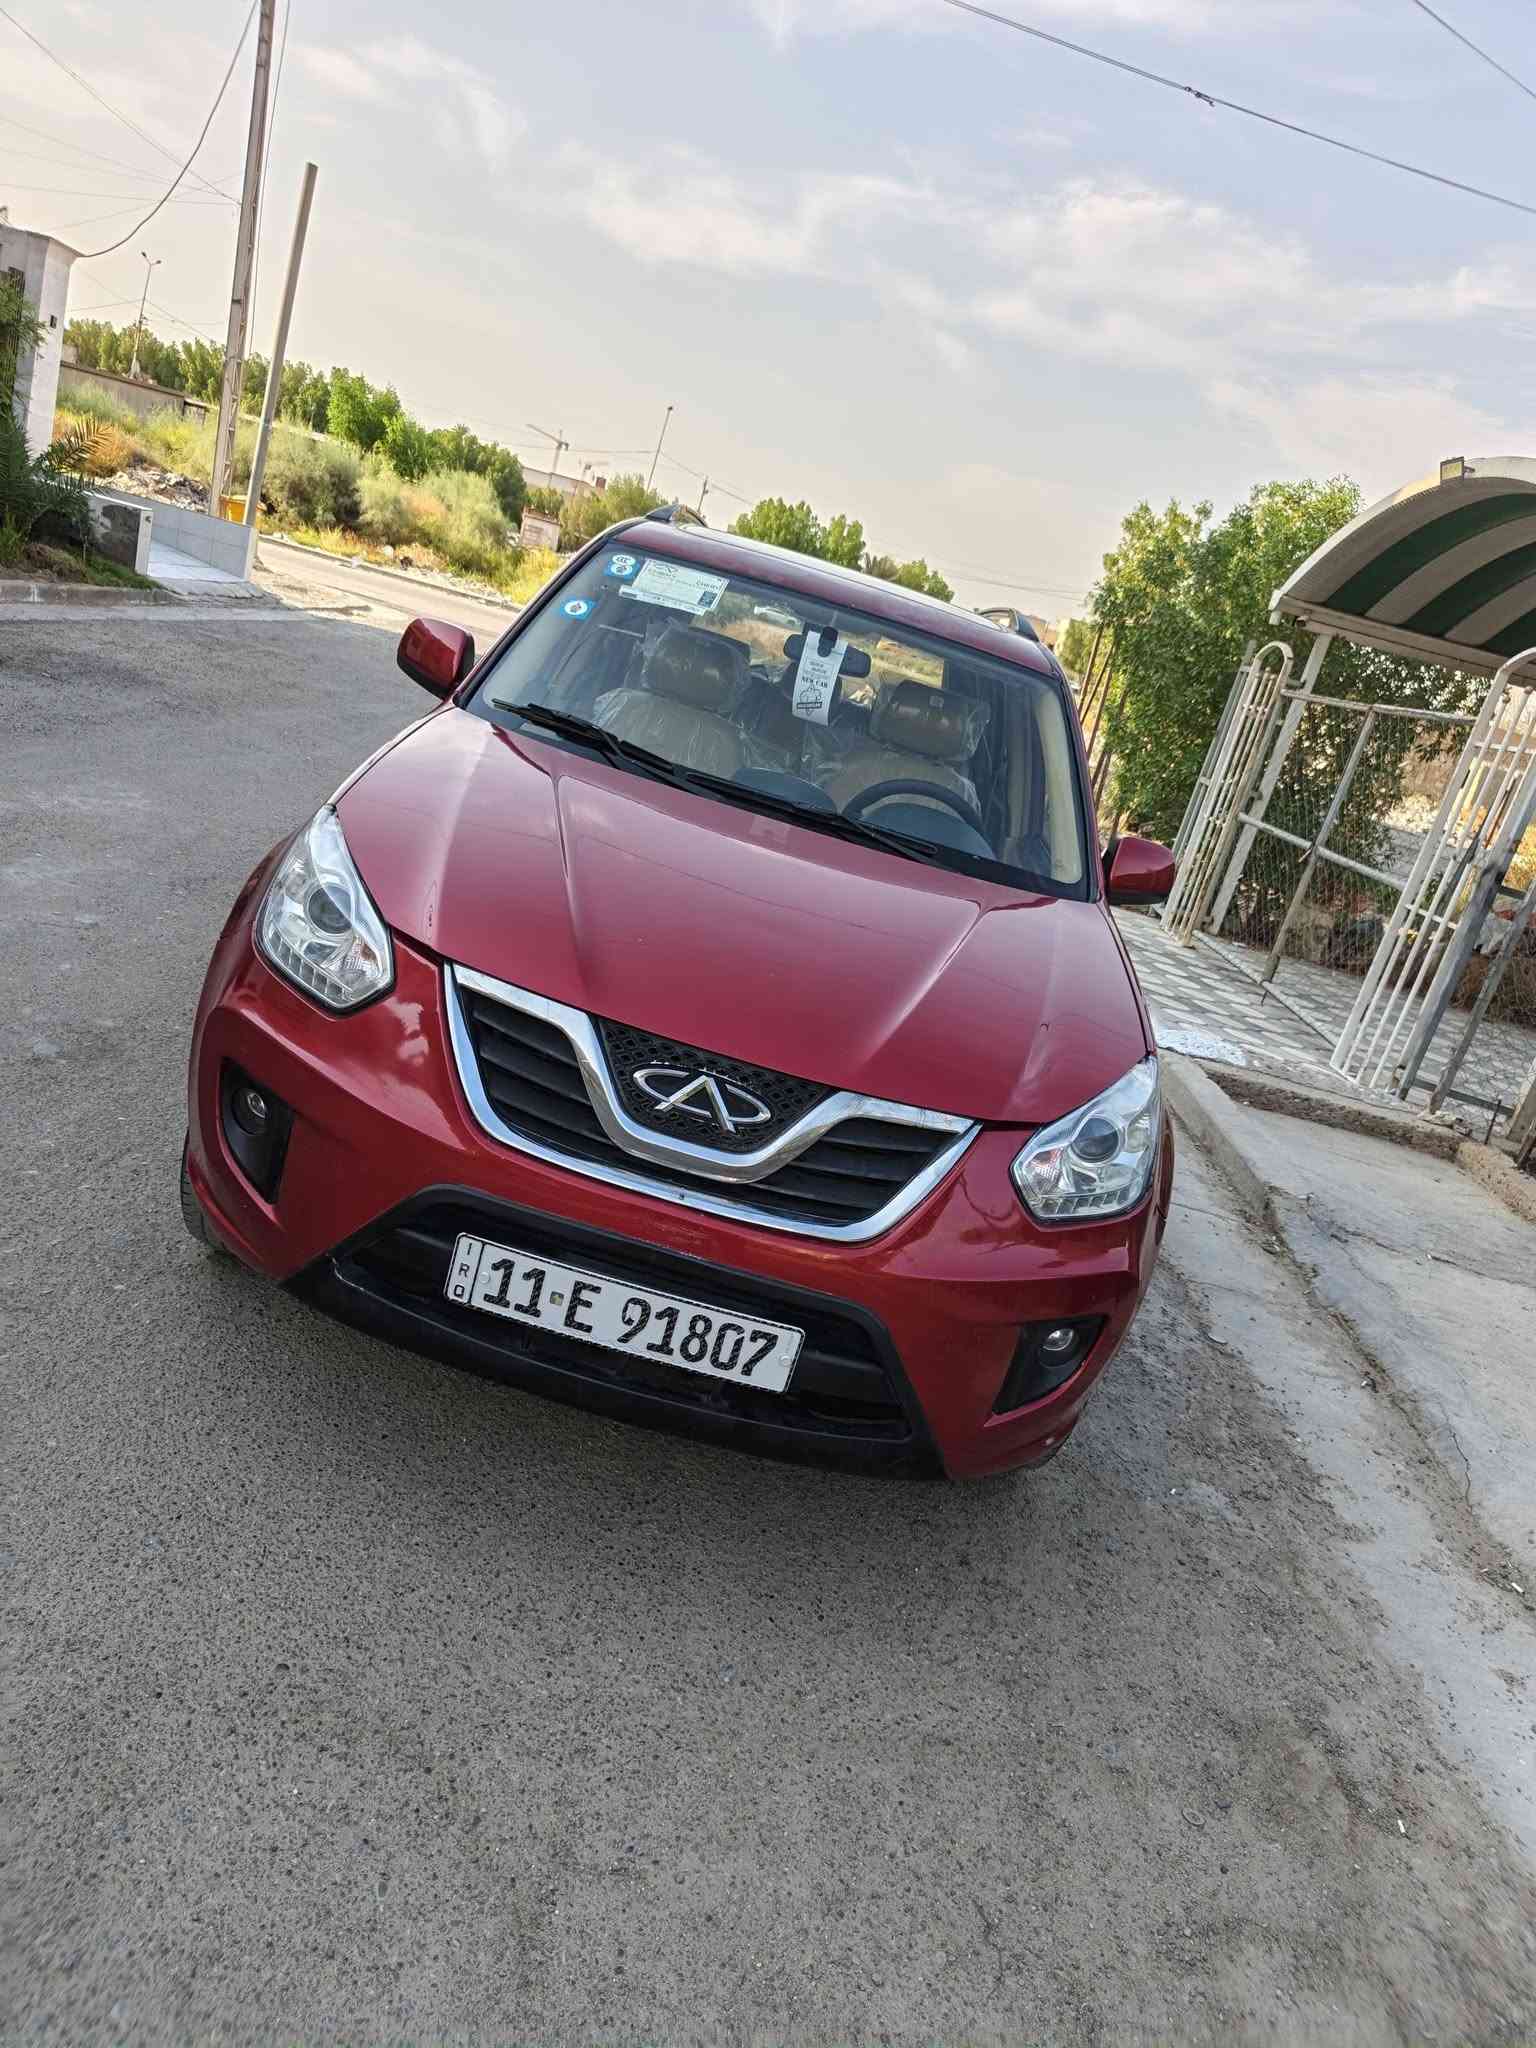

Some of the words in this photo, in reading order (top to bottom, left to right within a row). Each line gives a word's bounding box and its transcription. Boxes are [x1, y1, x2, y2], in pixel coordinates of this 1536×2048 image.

[483, 1258, 546, 1317] 11
[563, 1280, 602, 1333] E
[617, 1297, 778, 1376] 91807
